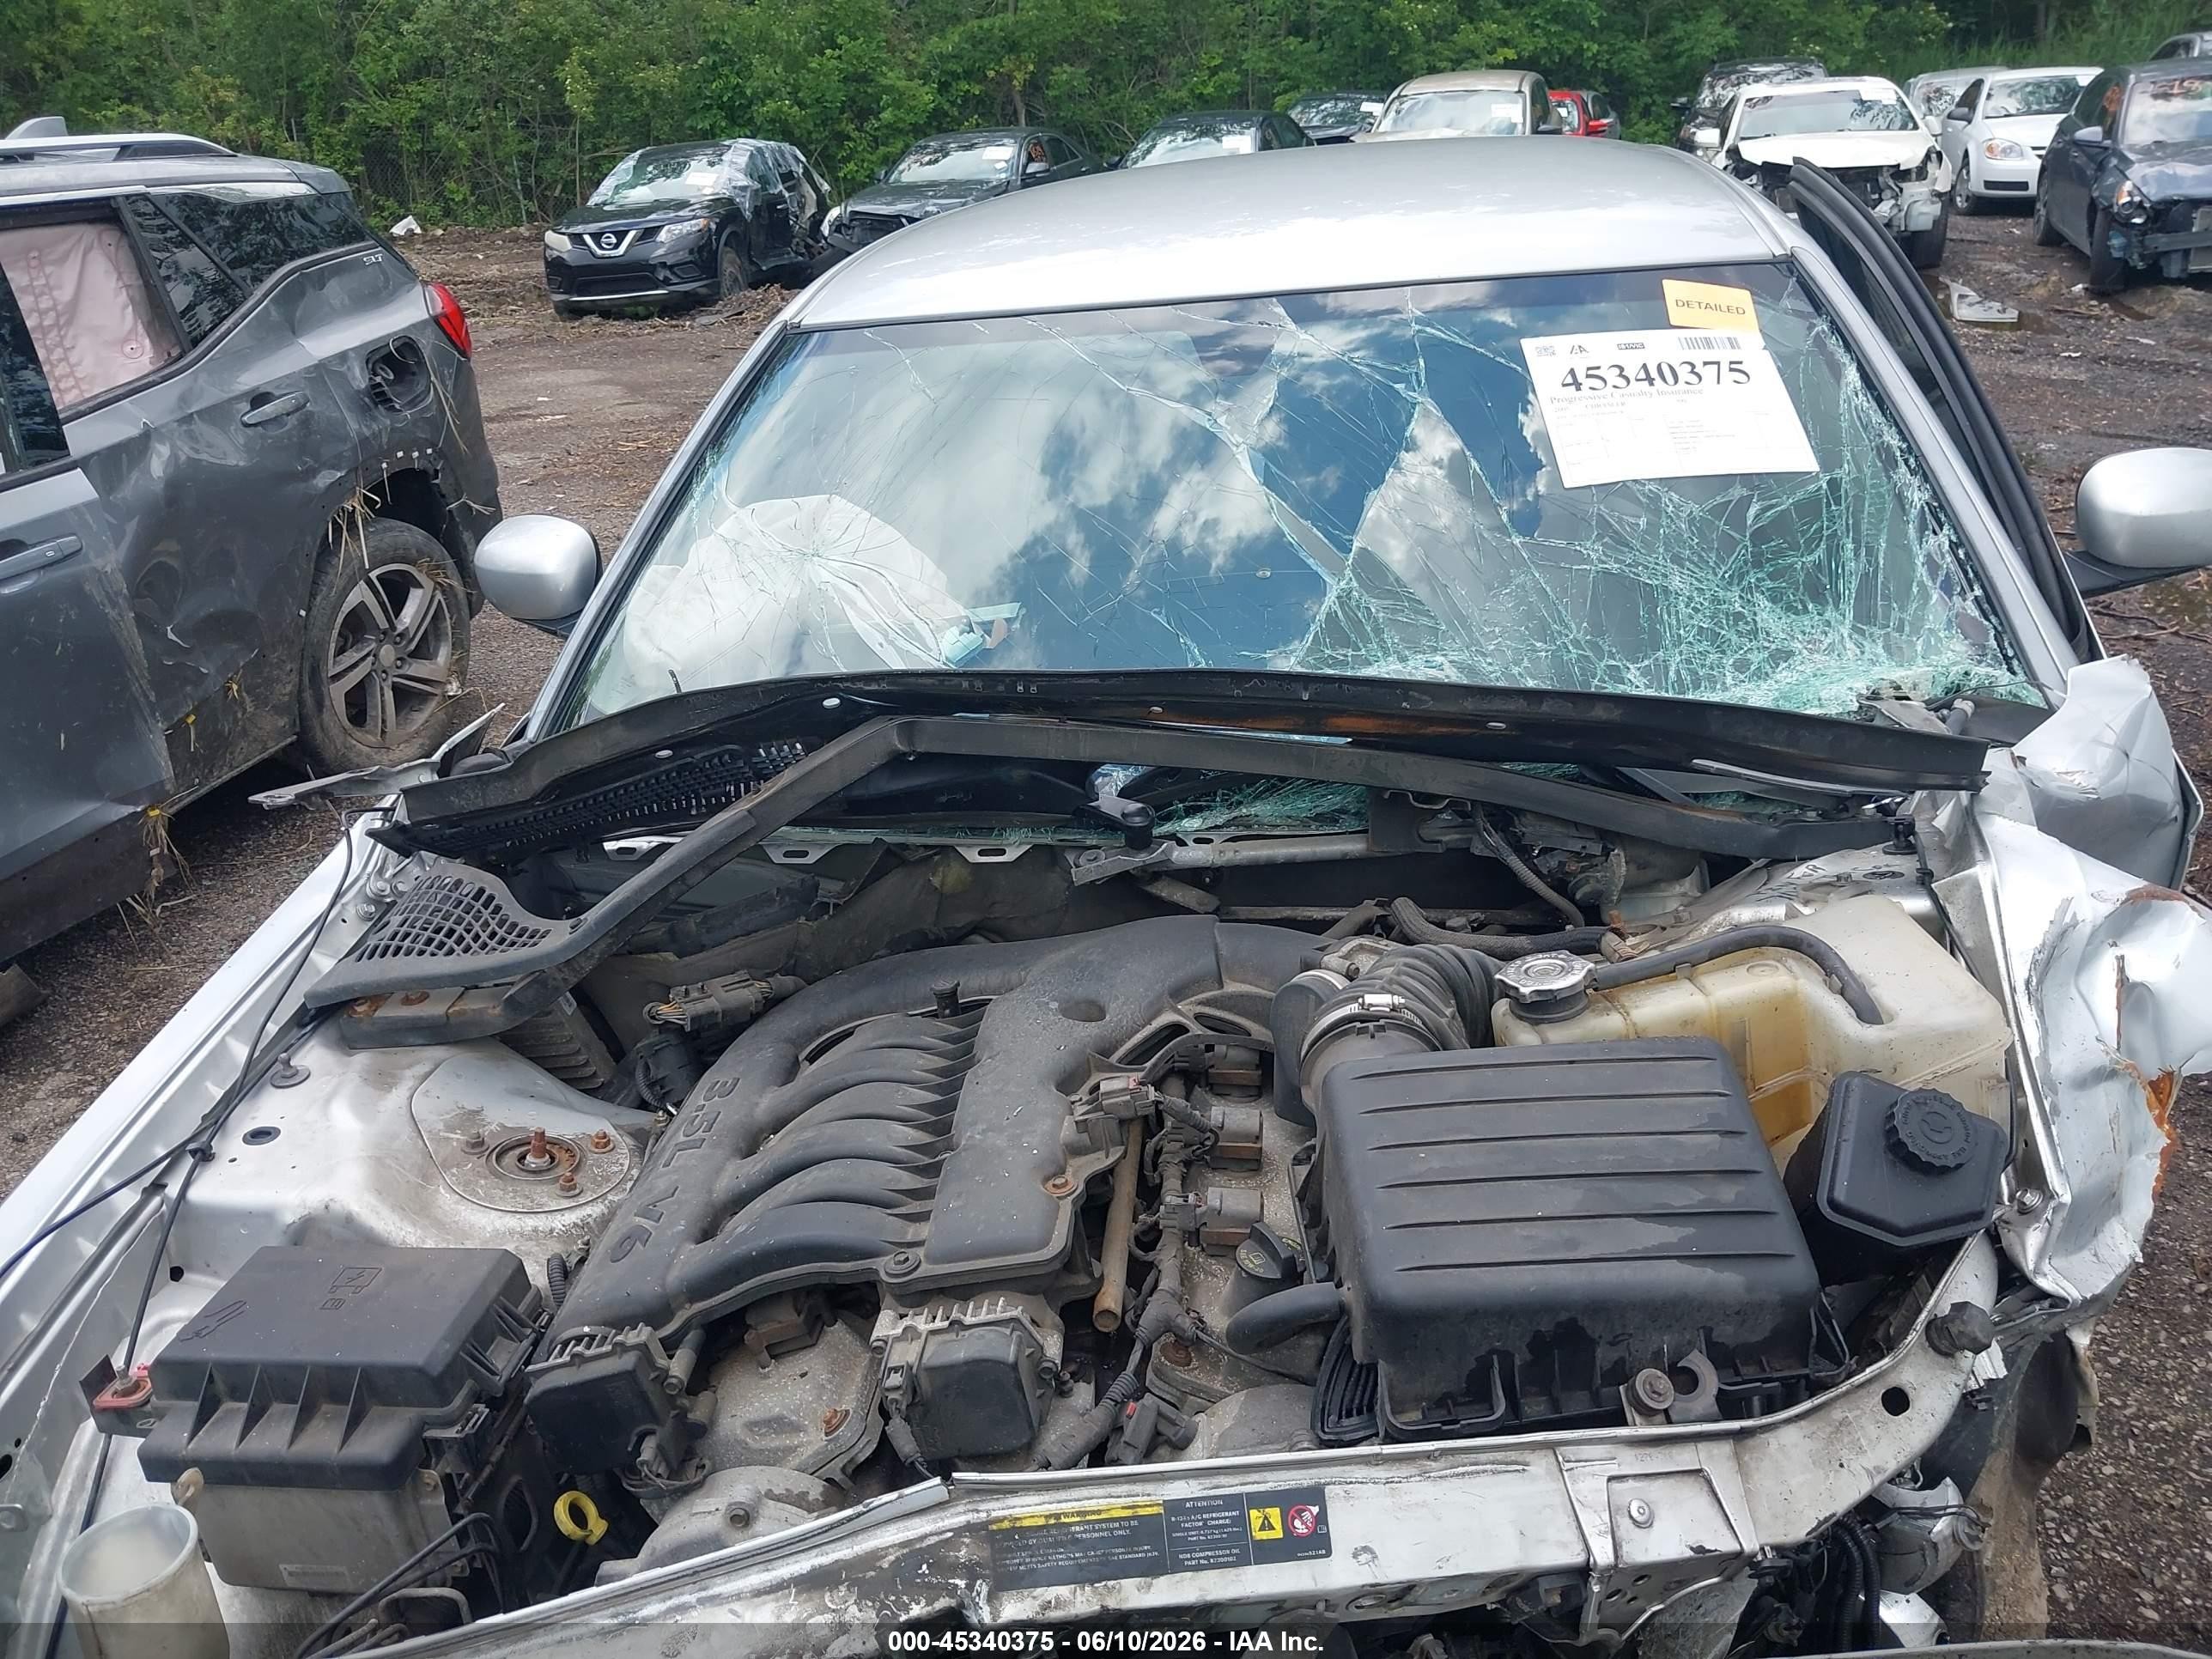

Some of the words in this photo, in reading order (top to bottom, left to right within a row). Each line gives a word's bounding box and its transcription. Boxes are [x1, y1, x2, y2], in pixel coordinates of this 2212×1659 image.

[362, 252, 383, 266] SLT
[1674, 297, 1747, 316] DETAILED
[1559, 360, 1751, 392] 45340375
[1549, 392, 1608, 404] Progressive
[1610, 389, 1654, 400] Casualty
[1656, 387, 1704, 398] Insurance
[661, 1077, 740, 1169] 3.5L
[610, 1185, 679, 1263] V6
[1185, 1499, 1223, 1508] ATTENTION
[1202, 1510, 1240, 1519] REFRIGERANT
[1073, 1530, 1112, 1540] PERSONNEL
[1191, 1549, 1231, 1559] COMPRESSOR
